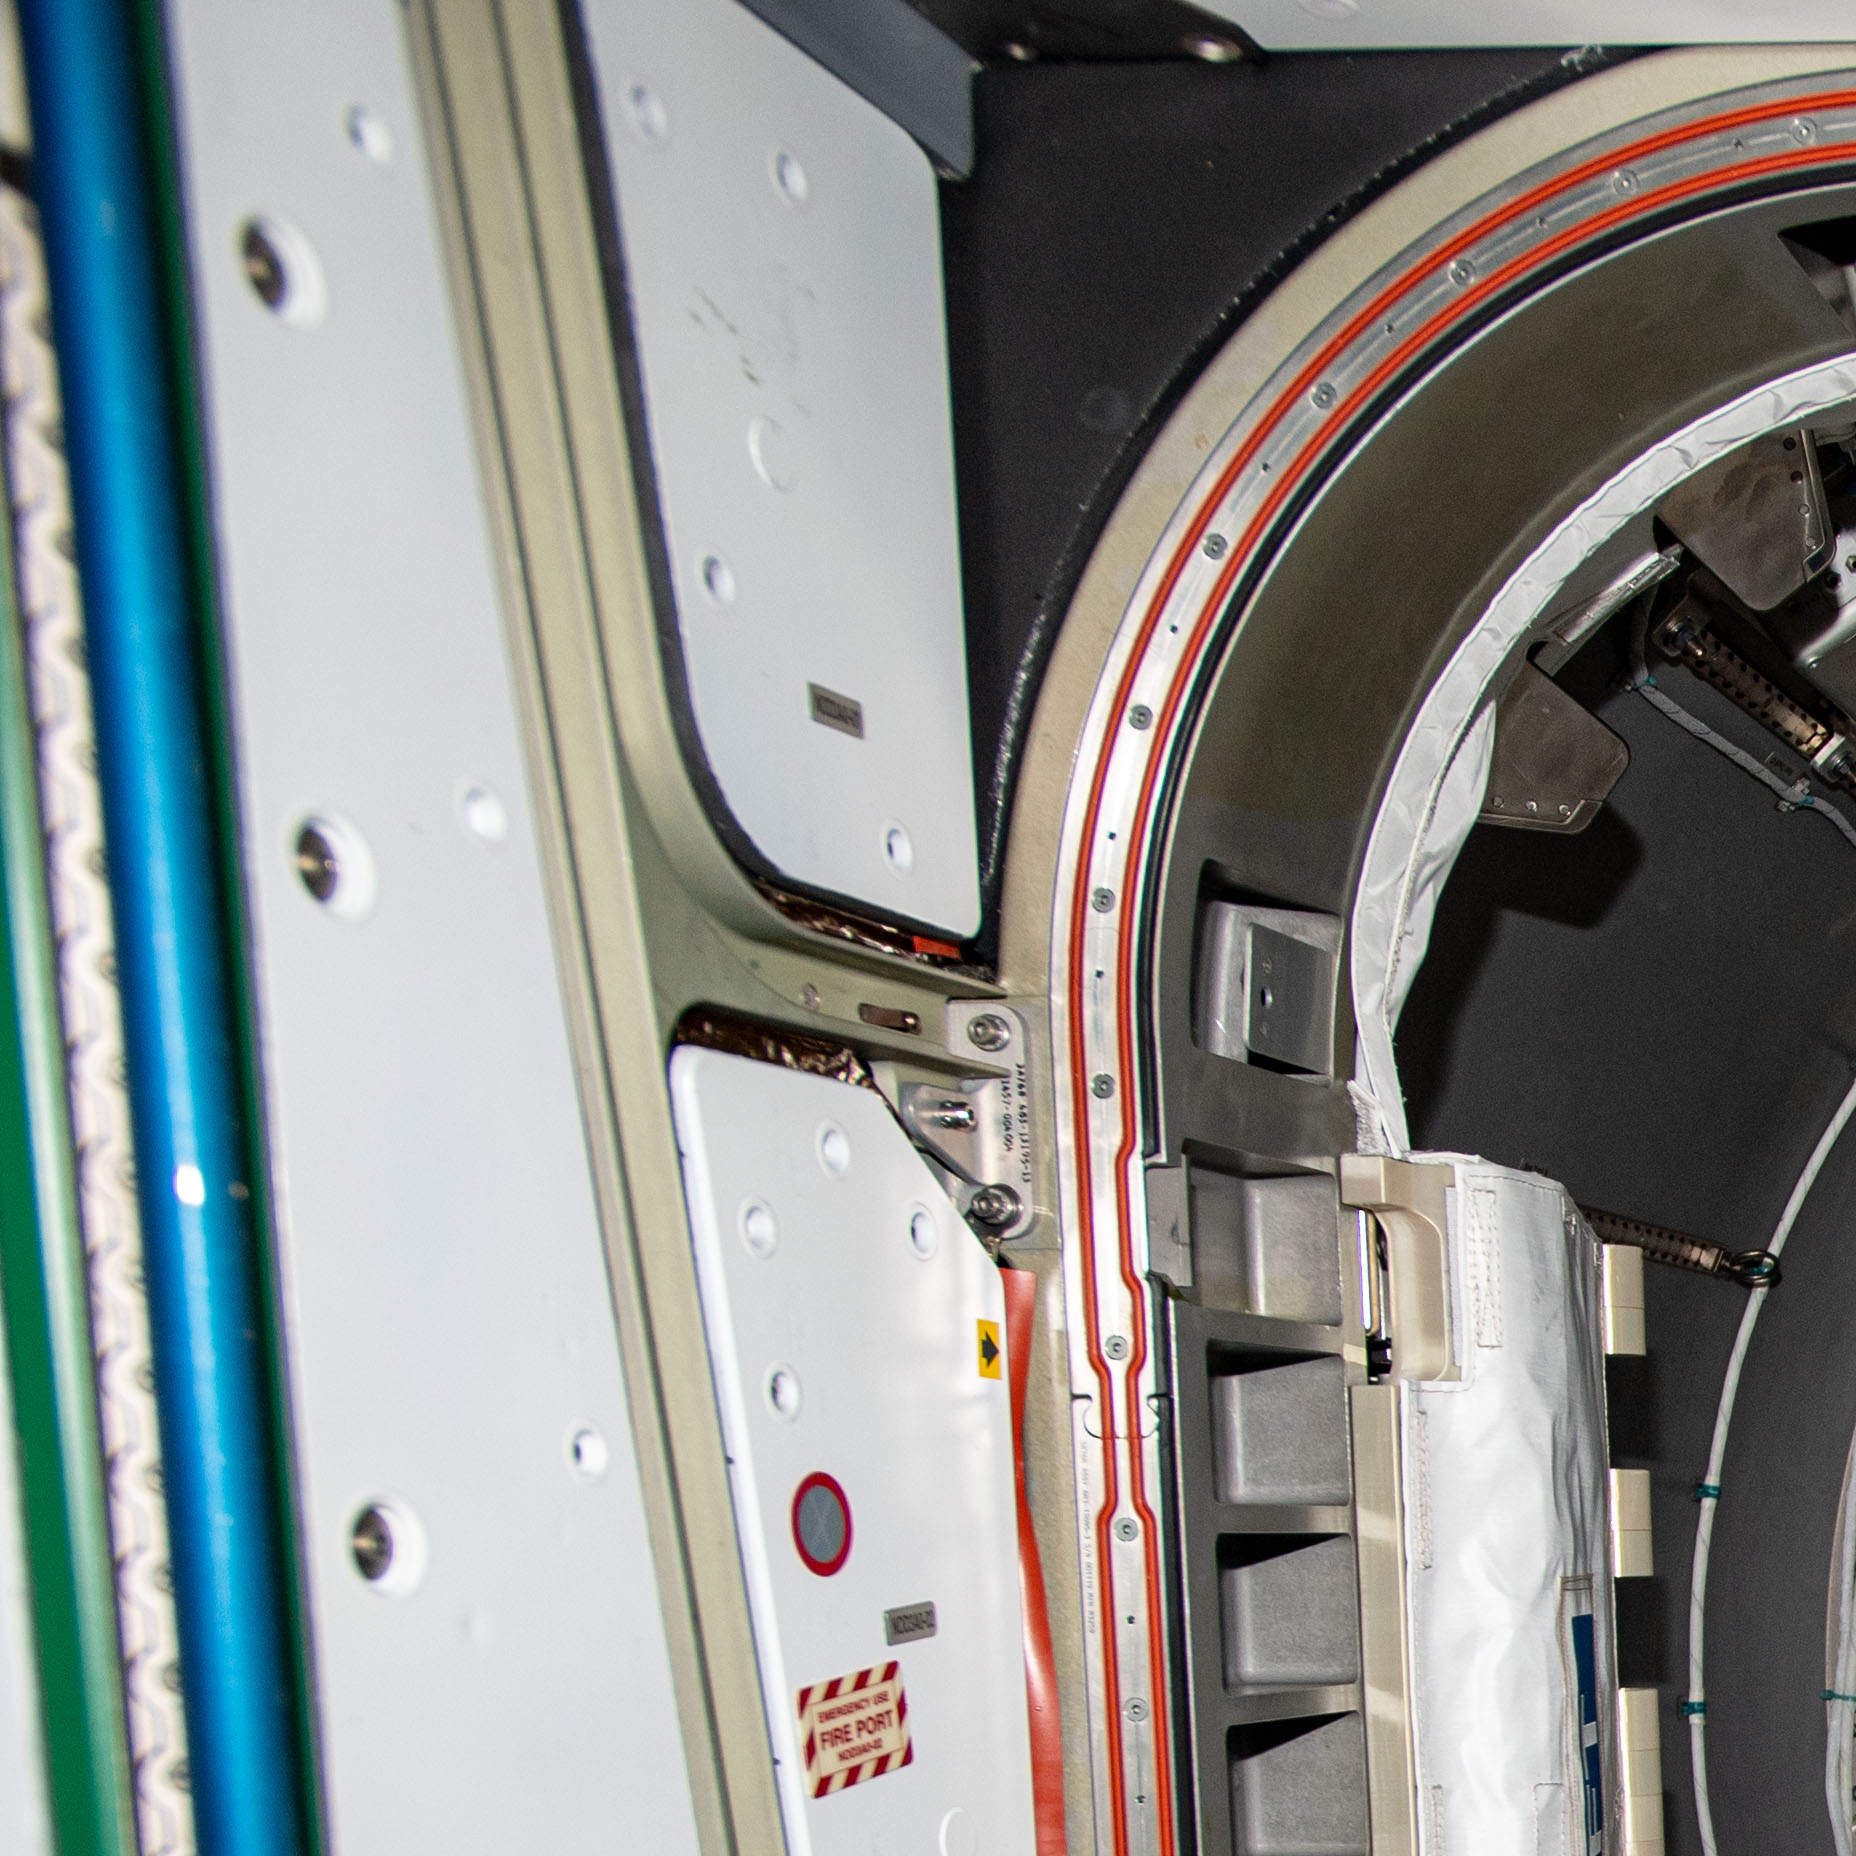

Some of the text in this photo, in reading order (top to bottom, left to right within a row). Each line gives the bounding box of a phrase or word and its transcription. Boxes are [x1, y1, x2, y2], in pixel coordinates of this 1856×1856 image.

[817, 1690, 889, 1723] EMERGENCY USE
[820, 1709, 893, 1752] FIRE PORT
